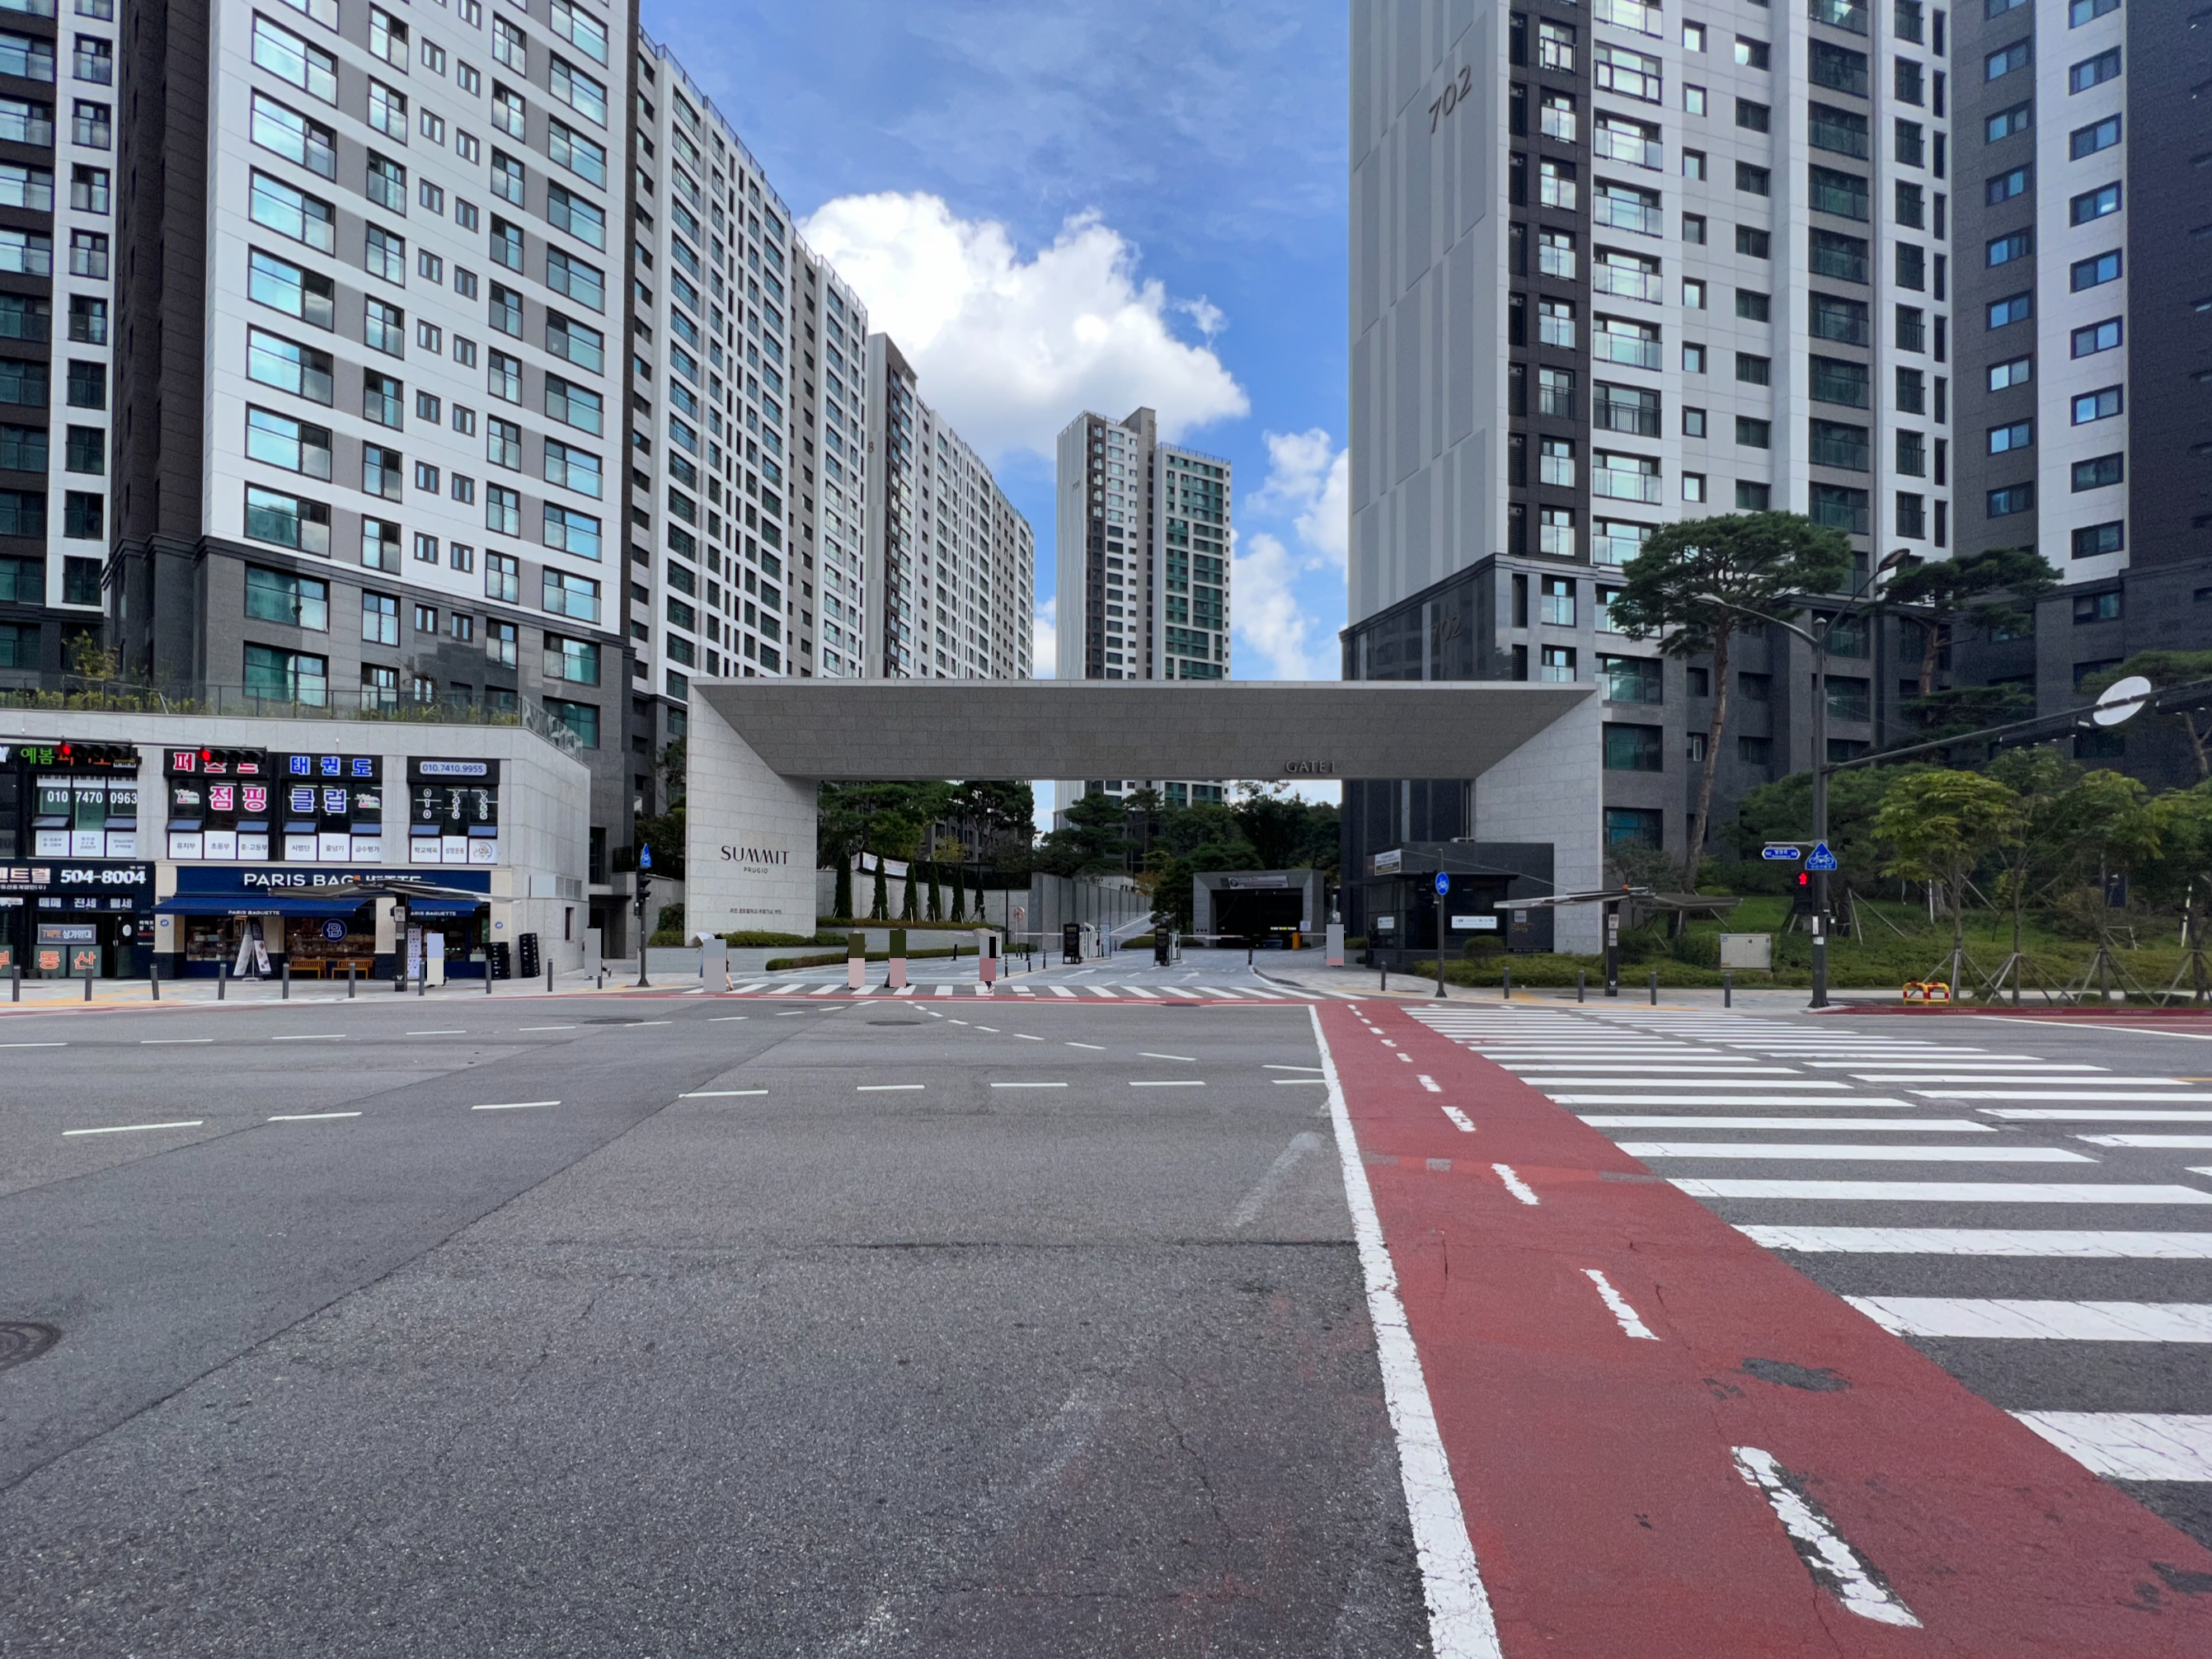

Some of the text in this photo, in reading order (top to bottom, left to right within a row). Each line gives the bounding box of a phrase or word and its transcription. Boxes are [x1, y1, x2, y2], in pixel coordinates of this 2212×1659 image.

[1428, 64, 1472, 134] 702
[289, 755, 373, 777] 태권도
[422, 764, 483, 773] 010.7410.9955
[1285, 760, 1327, 773] GATE
[47, 791, 138, 805] 010 7470 0963
[209, 786, 267, 811] 점핑
[290, 788, 346, 813] 클럽
[423, 788, 432, 819] 010
[176, 842, 196, 850] 유치부
[211, 843, 230, 851] 초등부
[291, 844, 311, 853] 시범단
[721, 845, 790, 865] SUMMIT
[60, 869, 147, 884] 504-8004
[244, 873, 306, 886] PARIS
[74, 897, 96, 909] 전세
